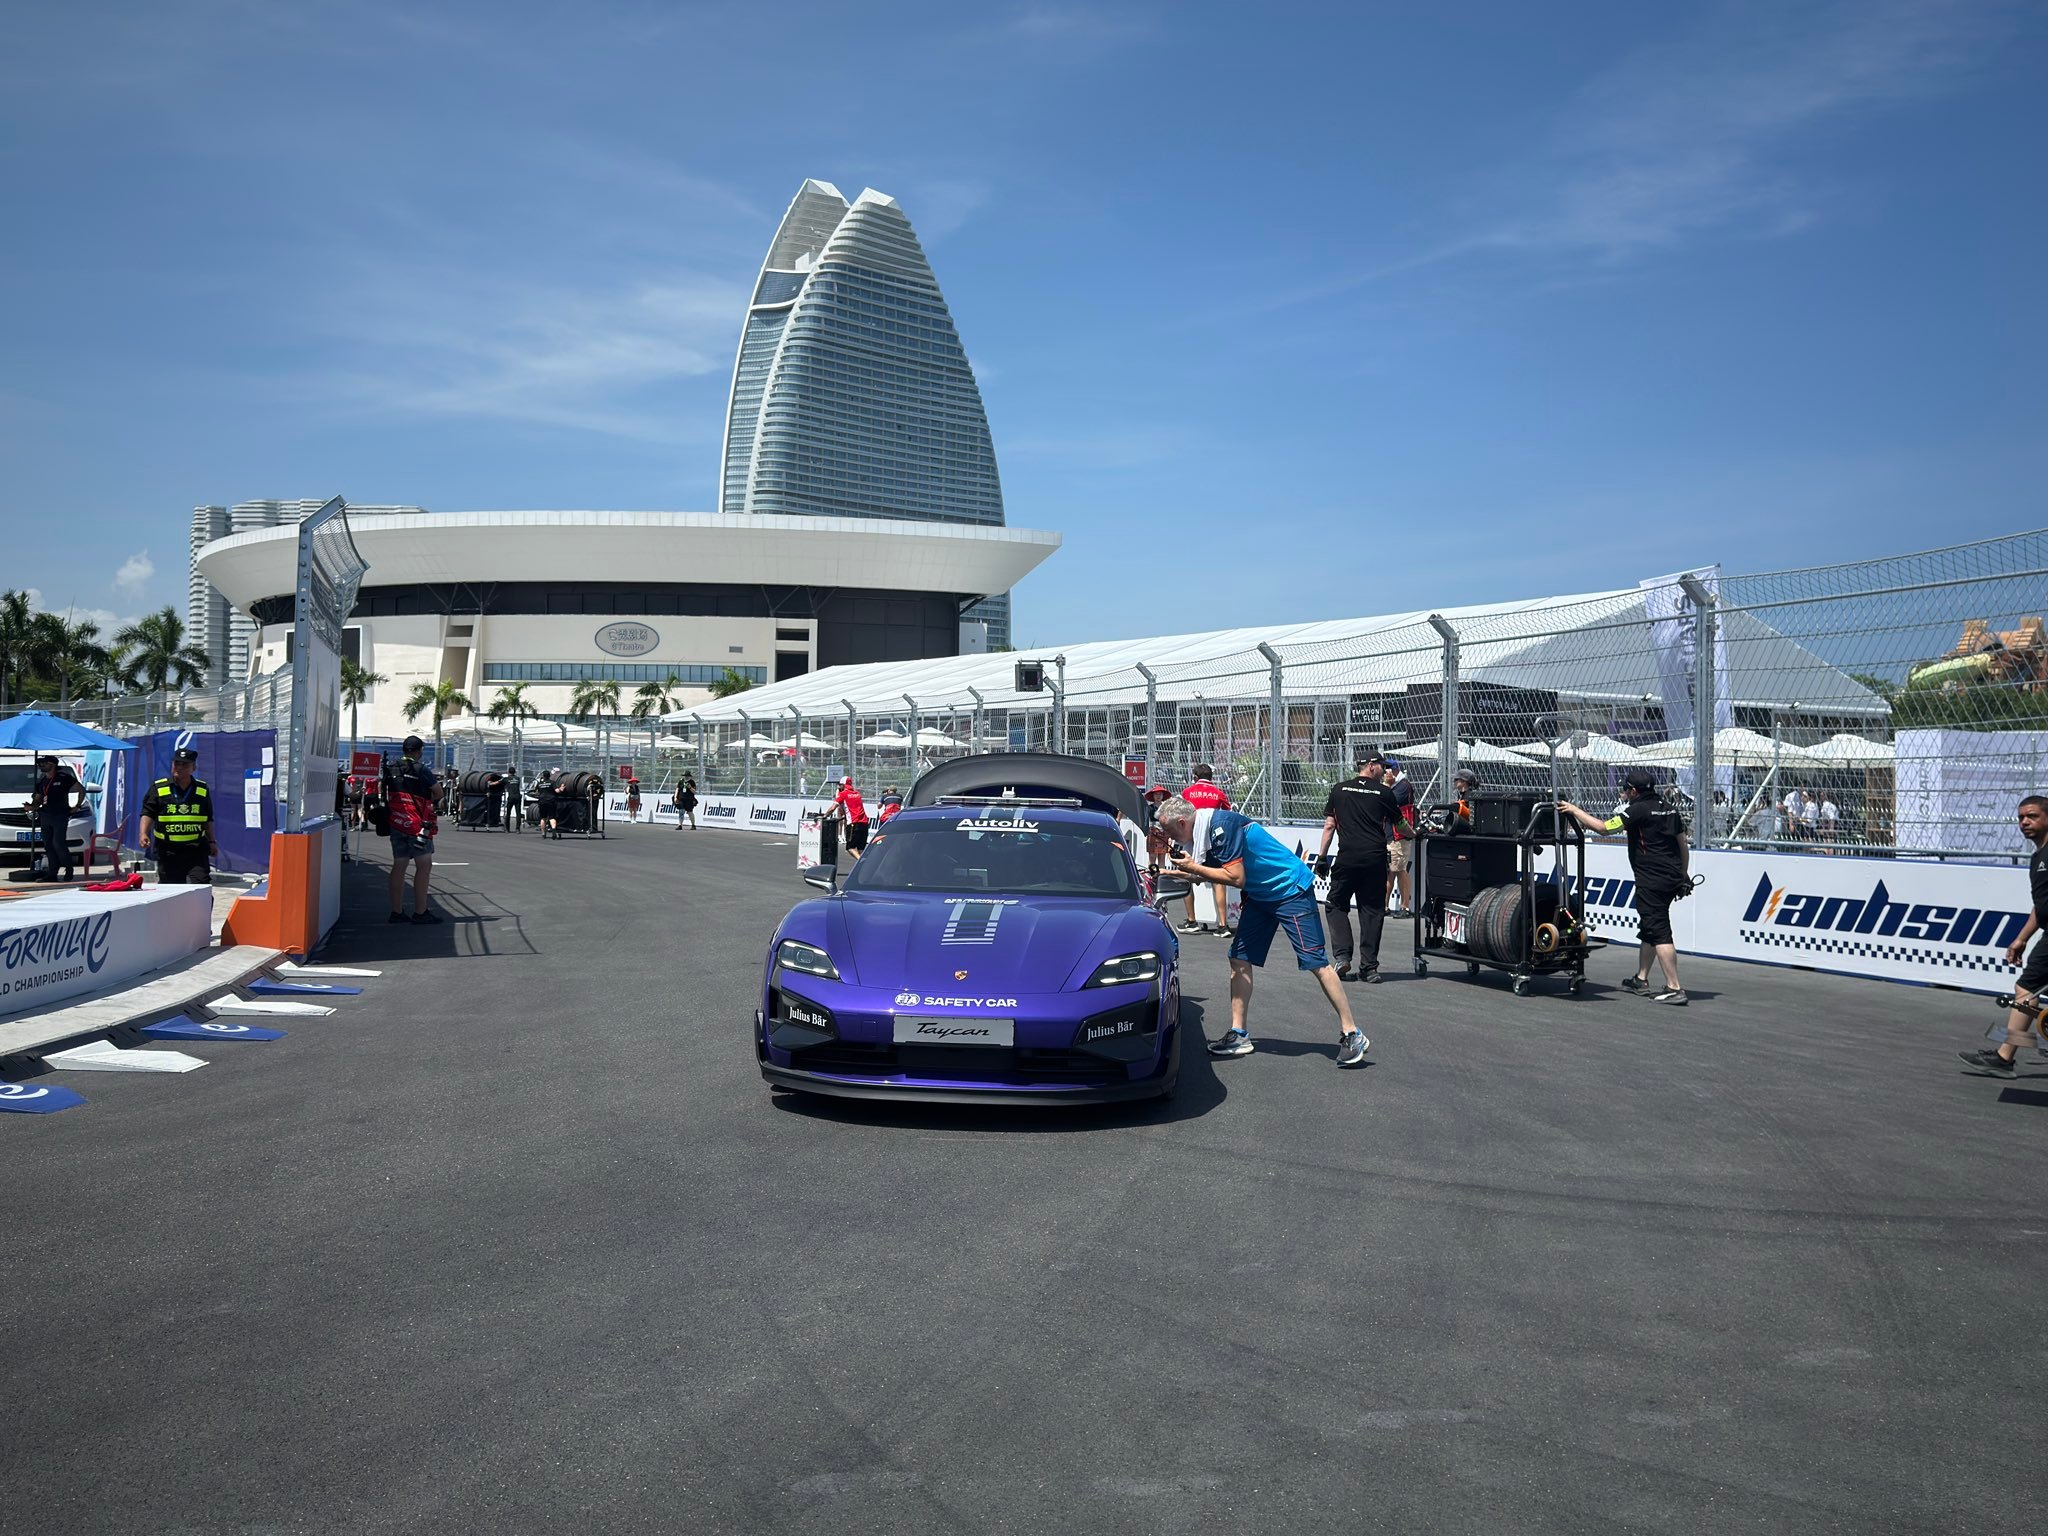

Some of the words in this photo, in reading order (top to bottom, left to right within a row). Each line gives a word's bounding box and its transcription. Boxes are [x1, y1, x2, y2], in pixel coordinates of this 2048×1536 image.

[1189, 791, 1219, 799] NISSAN
[165, 823, 202, 833] SECURITY
[957, 818, 1039, 828] Autoliv
[0, 917, 90, 970] FORMULA
[14, 965, 84, 992] CHAMPIONSHIP
[924, 996, 983, 1007] SAFETY
[985, 998, 1018, 1008] CAR
[789, 1006, 811, 1023] Julius
[916, 1022, 990, 1039] Taycan
[1087, 1025, 1115, 1042] Julius
